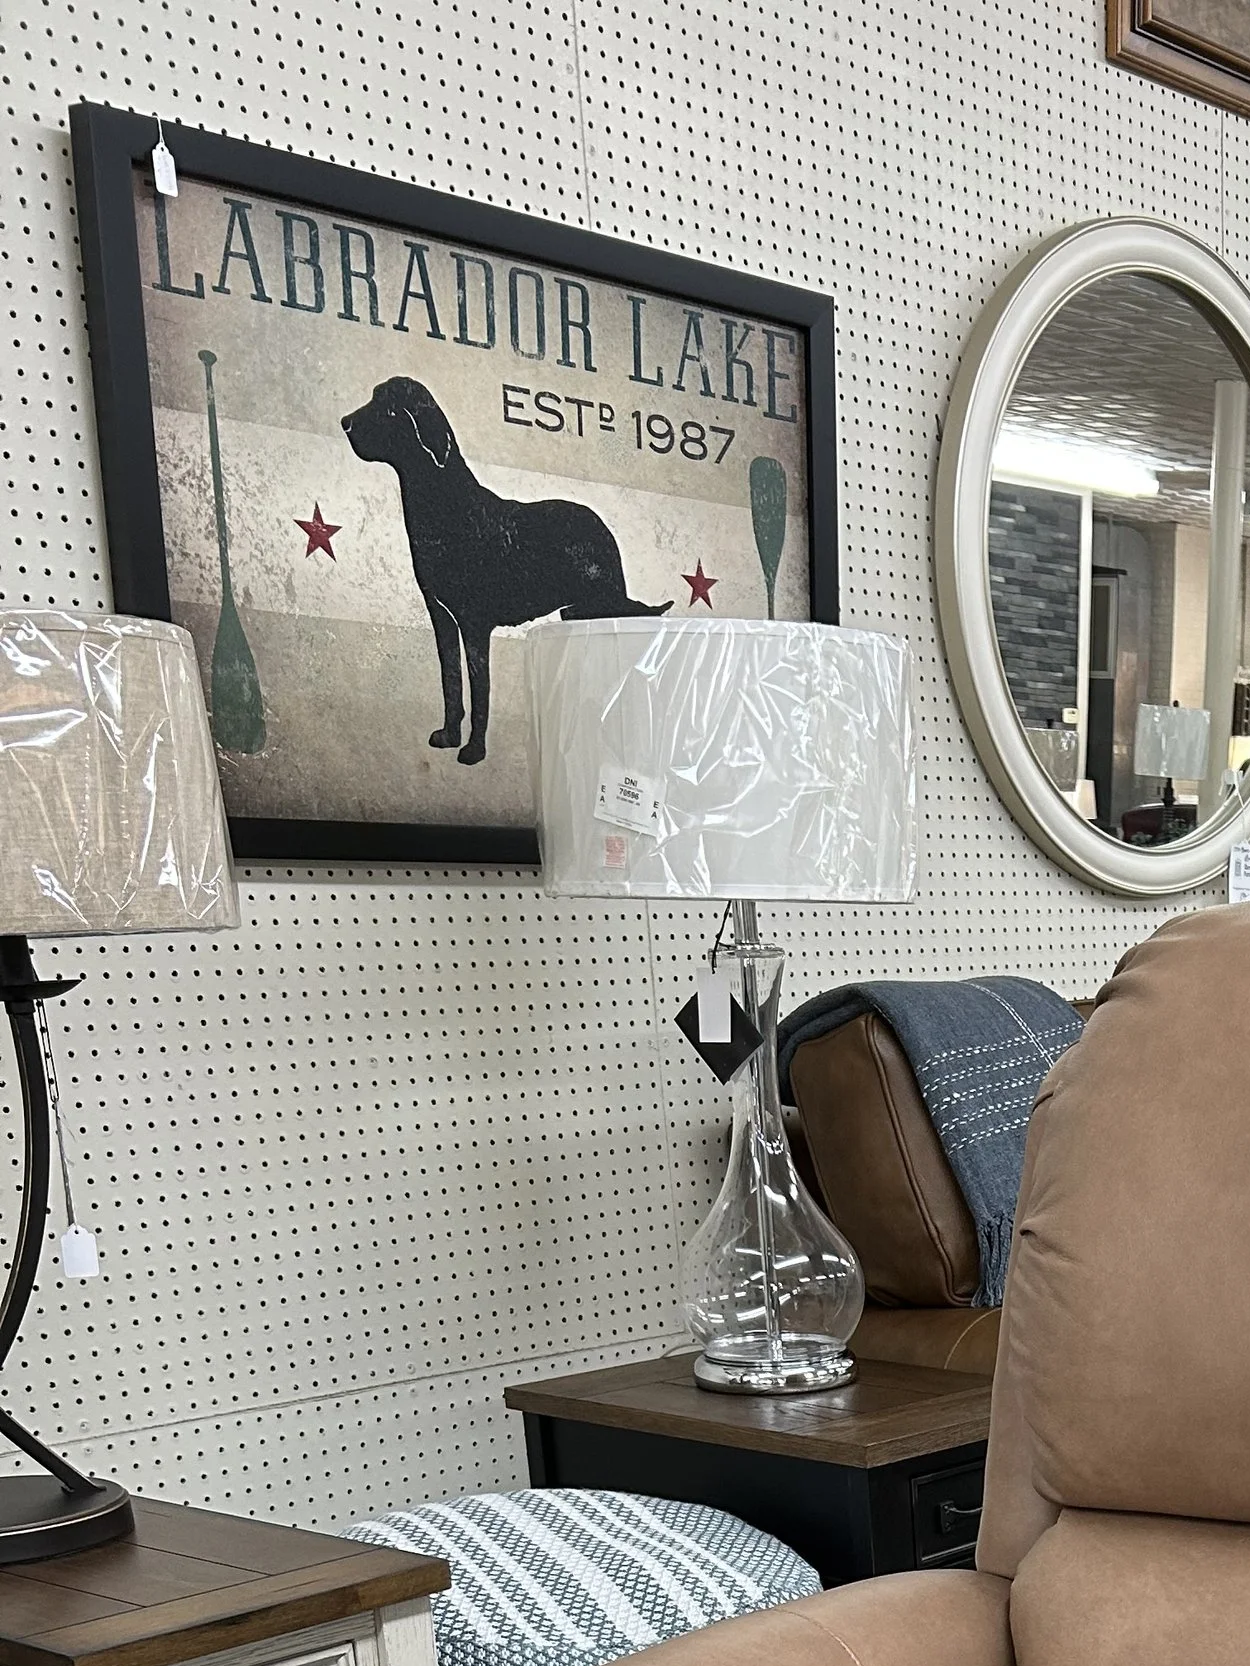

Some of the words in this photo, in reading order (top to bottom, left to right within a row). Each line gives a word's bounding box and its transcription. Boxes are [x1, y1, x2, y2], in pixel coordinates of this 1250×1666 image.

[143, 179, 598, 373] LABRADOR
[627, 295, 797, 424] LAKE
[631, 410, 736, 464] 1987
